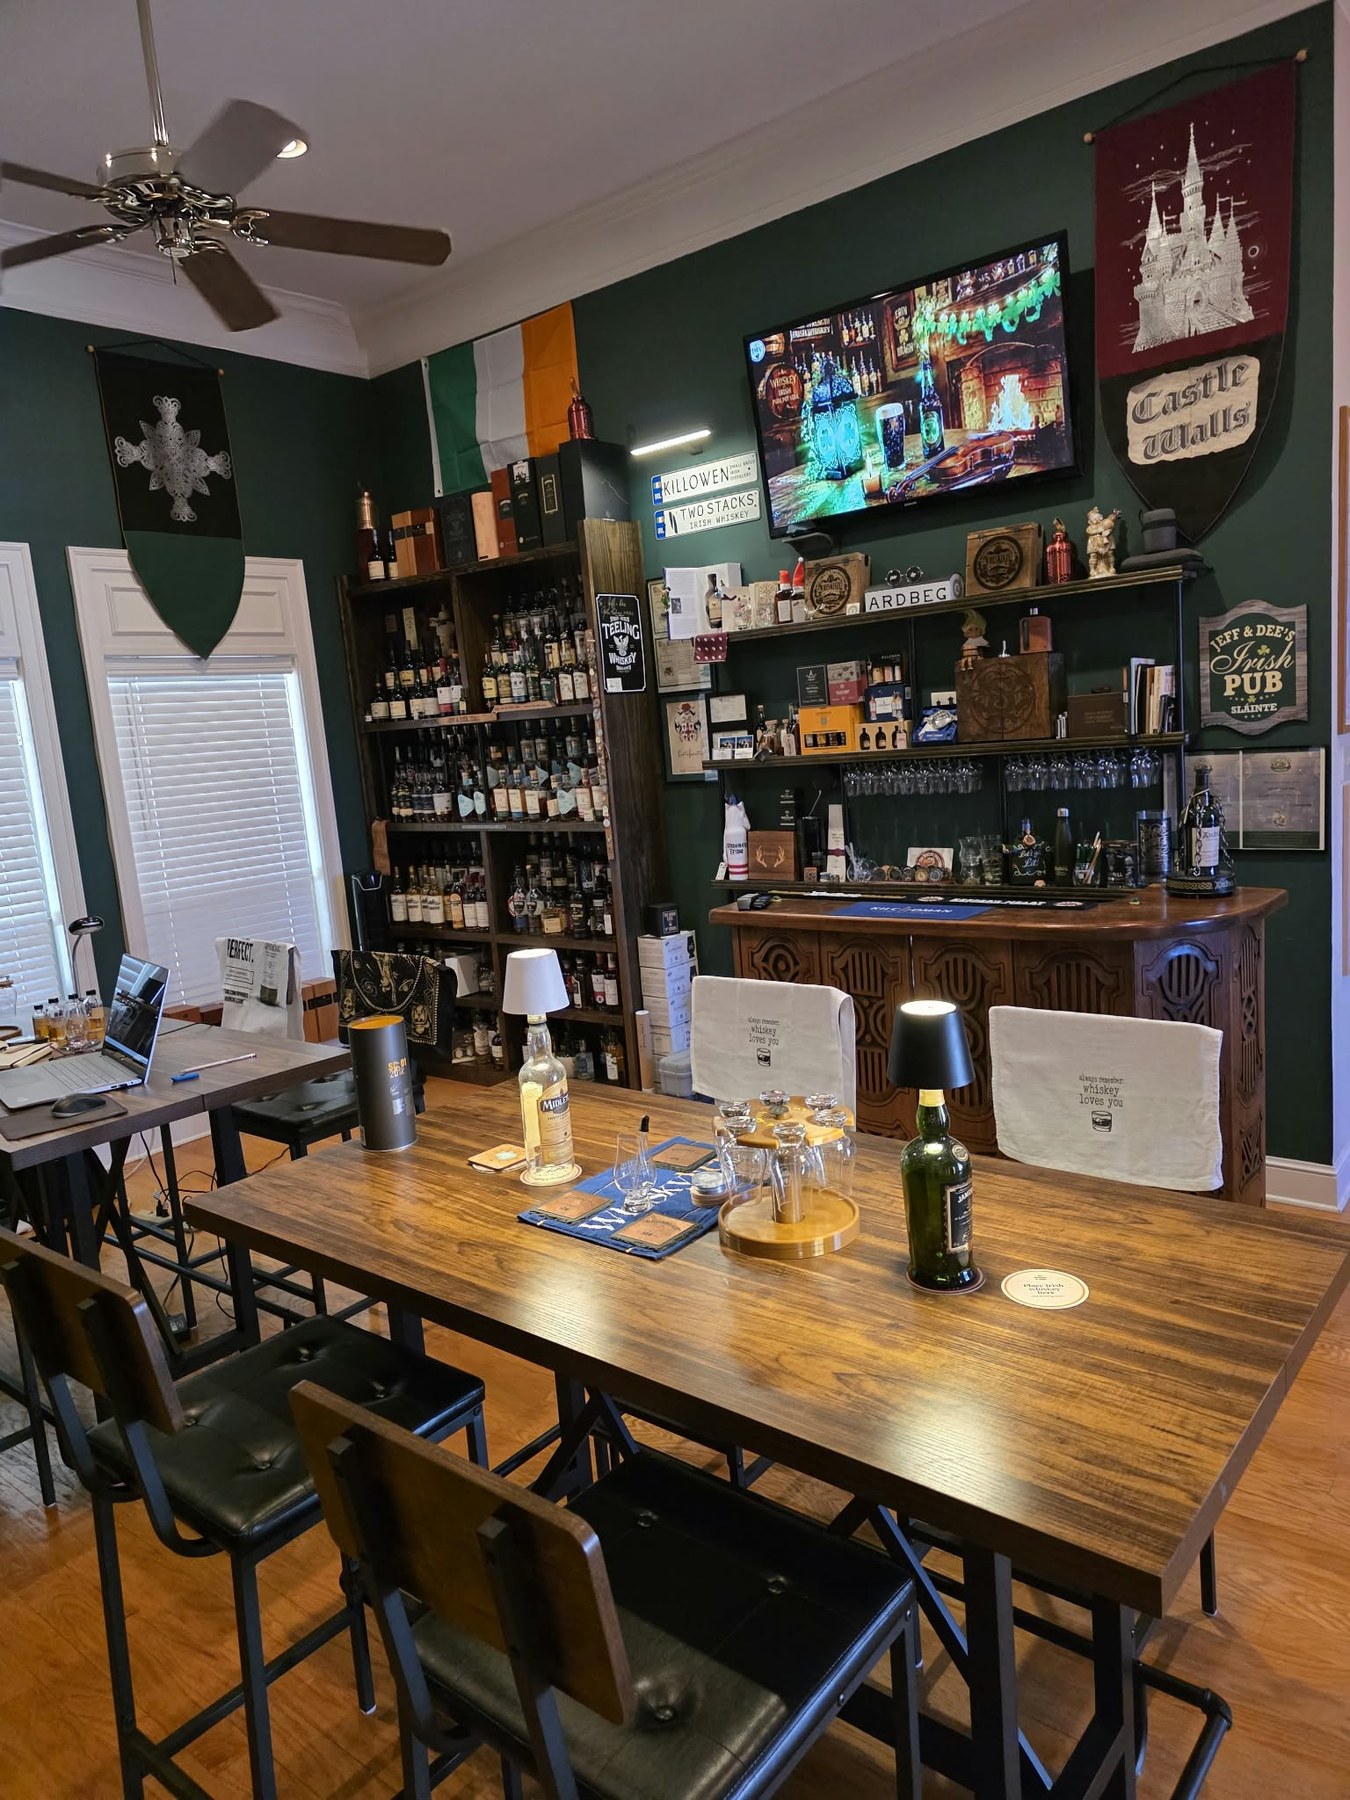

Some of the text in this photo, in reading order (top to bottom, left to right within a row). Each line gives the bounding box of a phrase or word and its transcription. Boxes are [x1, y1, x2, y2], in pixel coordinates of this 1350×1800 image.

[1132, 361, 1249, 425] Castle
[1142, 401, 1250, 460] Walls
[663, 466, 729, 496] KILLOWEN
[680, 493, 754, 520] TWO STACKS
[690, 510, 750, 529] IRISH WHISKEY
[868, 587, 948, 611] ARDBEG
[602, 621, 640, 640] TEELING
[1210, 624, 1296, 653] JEFF & DEE'S
[608, 652, 637, 666] WHISKEY
[1210, 641, 1294, 674] Irish
[1223, 670, 1283, 696] PUB
[1230, 702, 1278, 714] SLÁINTE
[1079, 1094, 1123, 1108] loves you
[1083, 1084, 1120, 1097] whiskey
